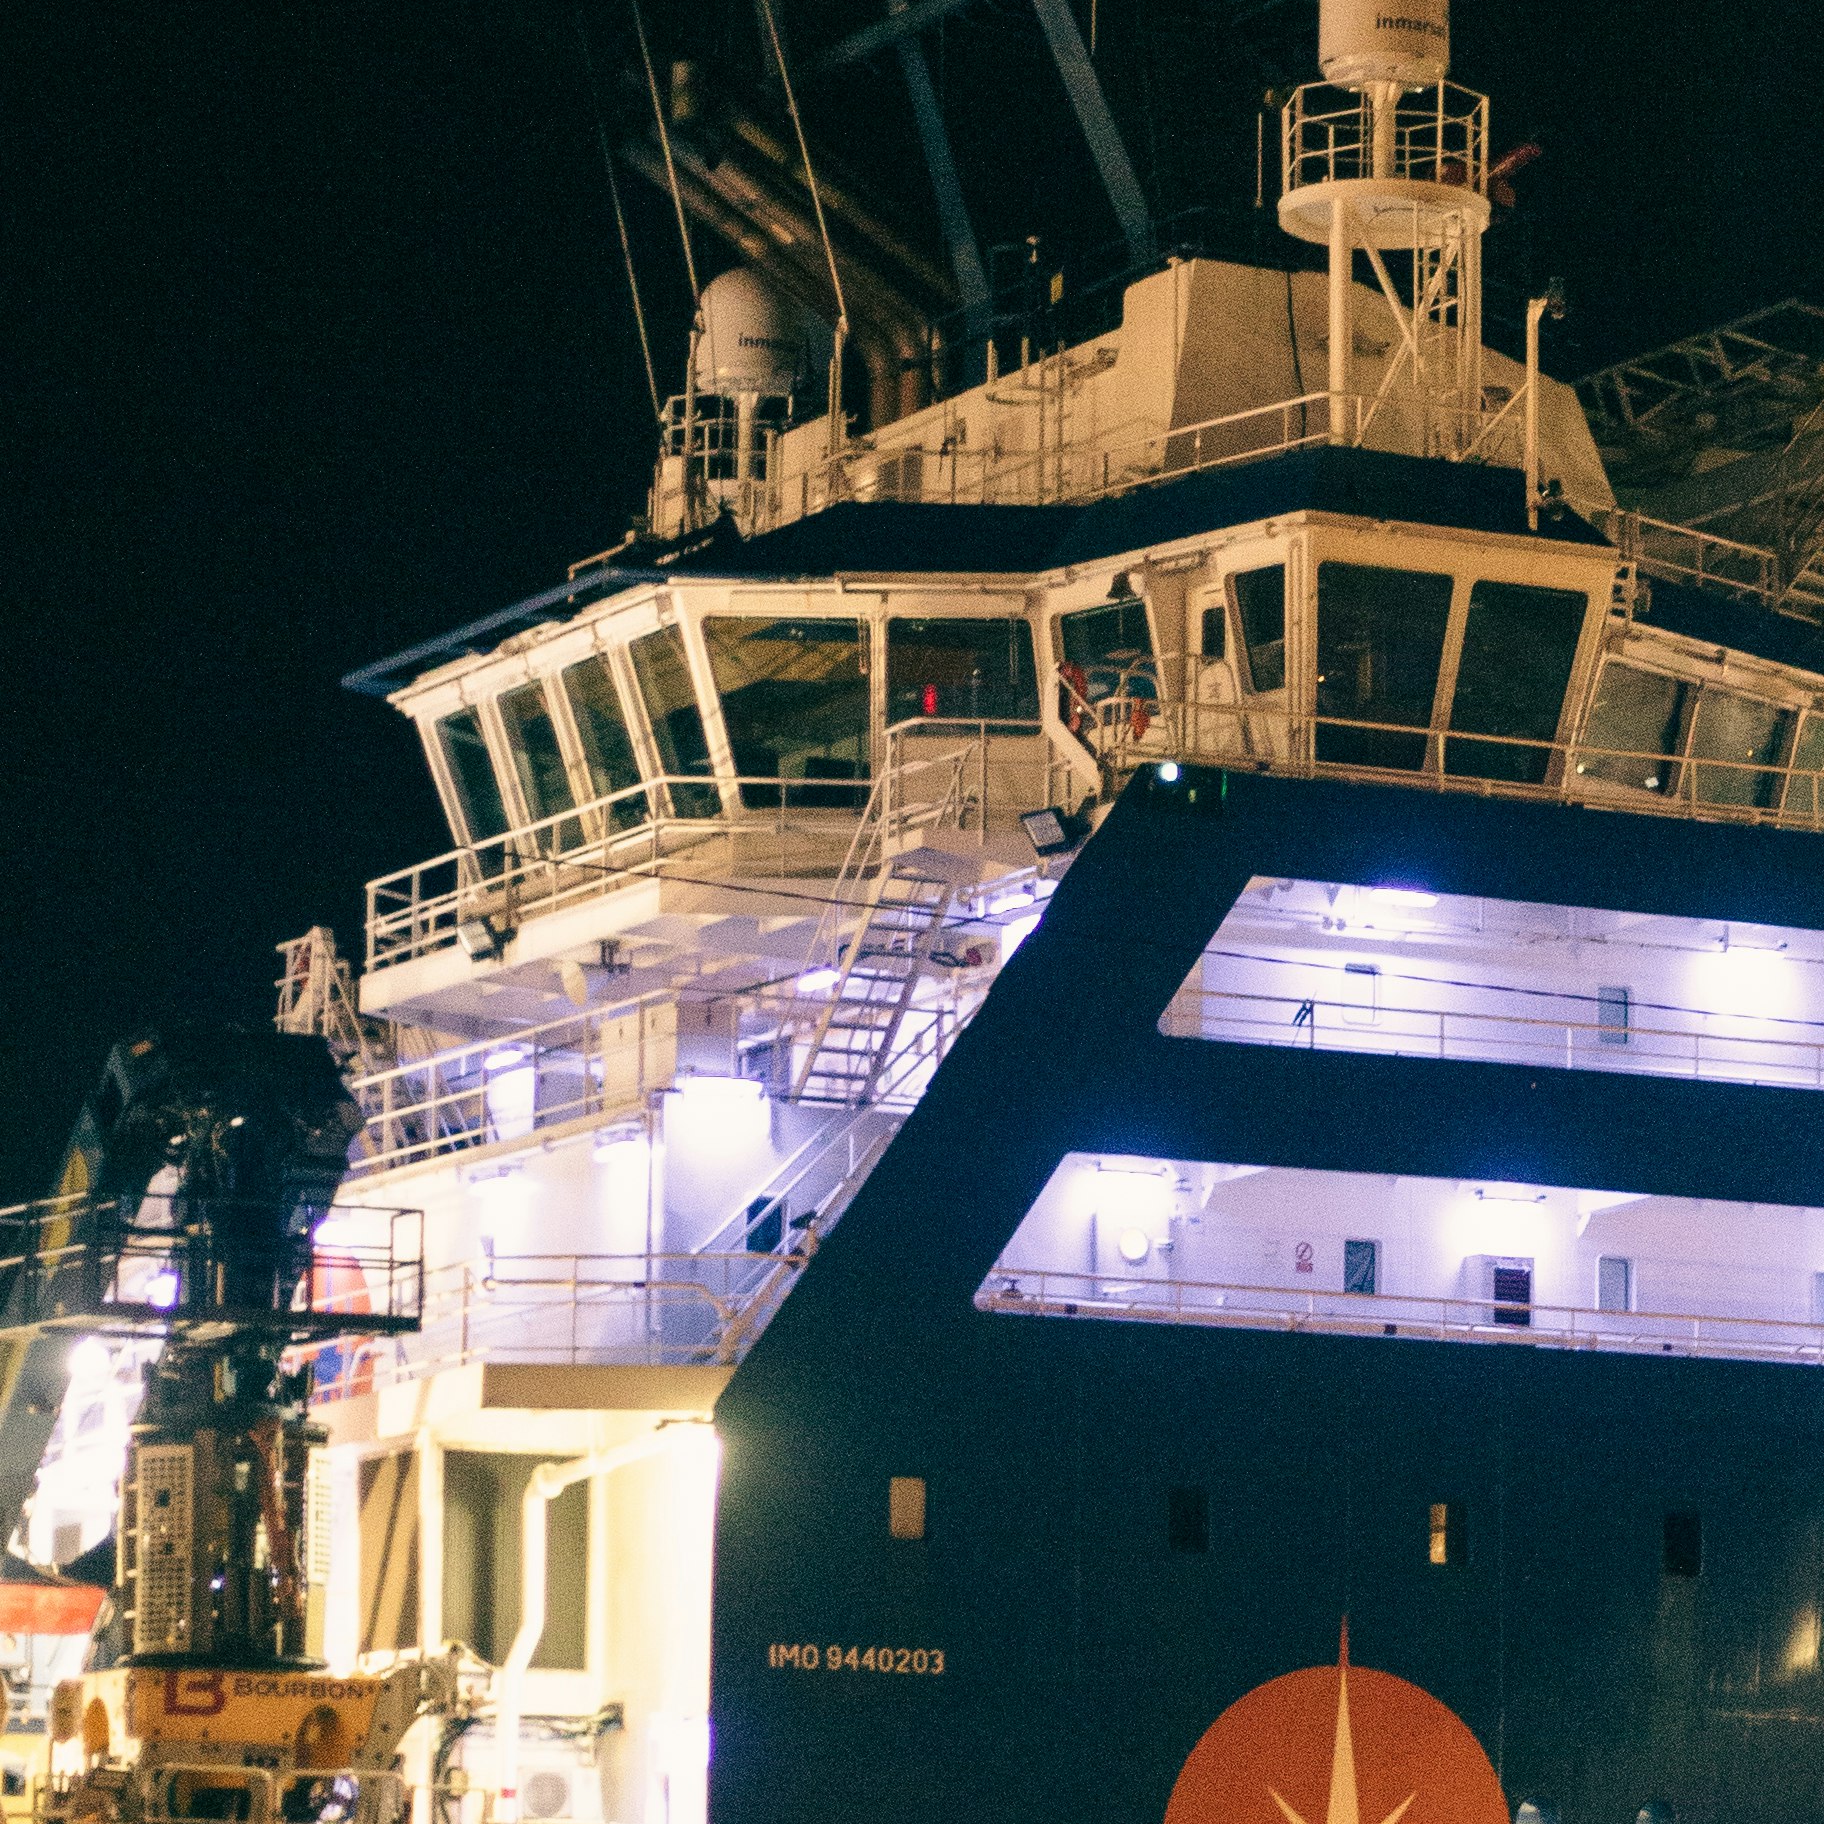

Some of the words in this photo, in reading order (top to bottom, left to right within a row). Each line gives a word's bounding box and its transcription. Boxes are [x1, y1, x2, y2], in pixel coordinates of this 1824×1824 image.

[768, 1642, 820, 1671] IMO
[826, 1644, 946, 1676] 9440203
[233, 1678, 364, 1699] BOURBON
